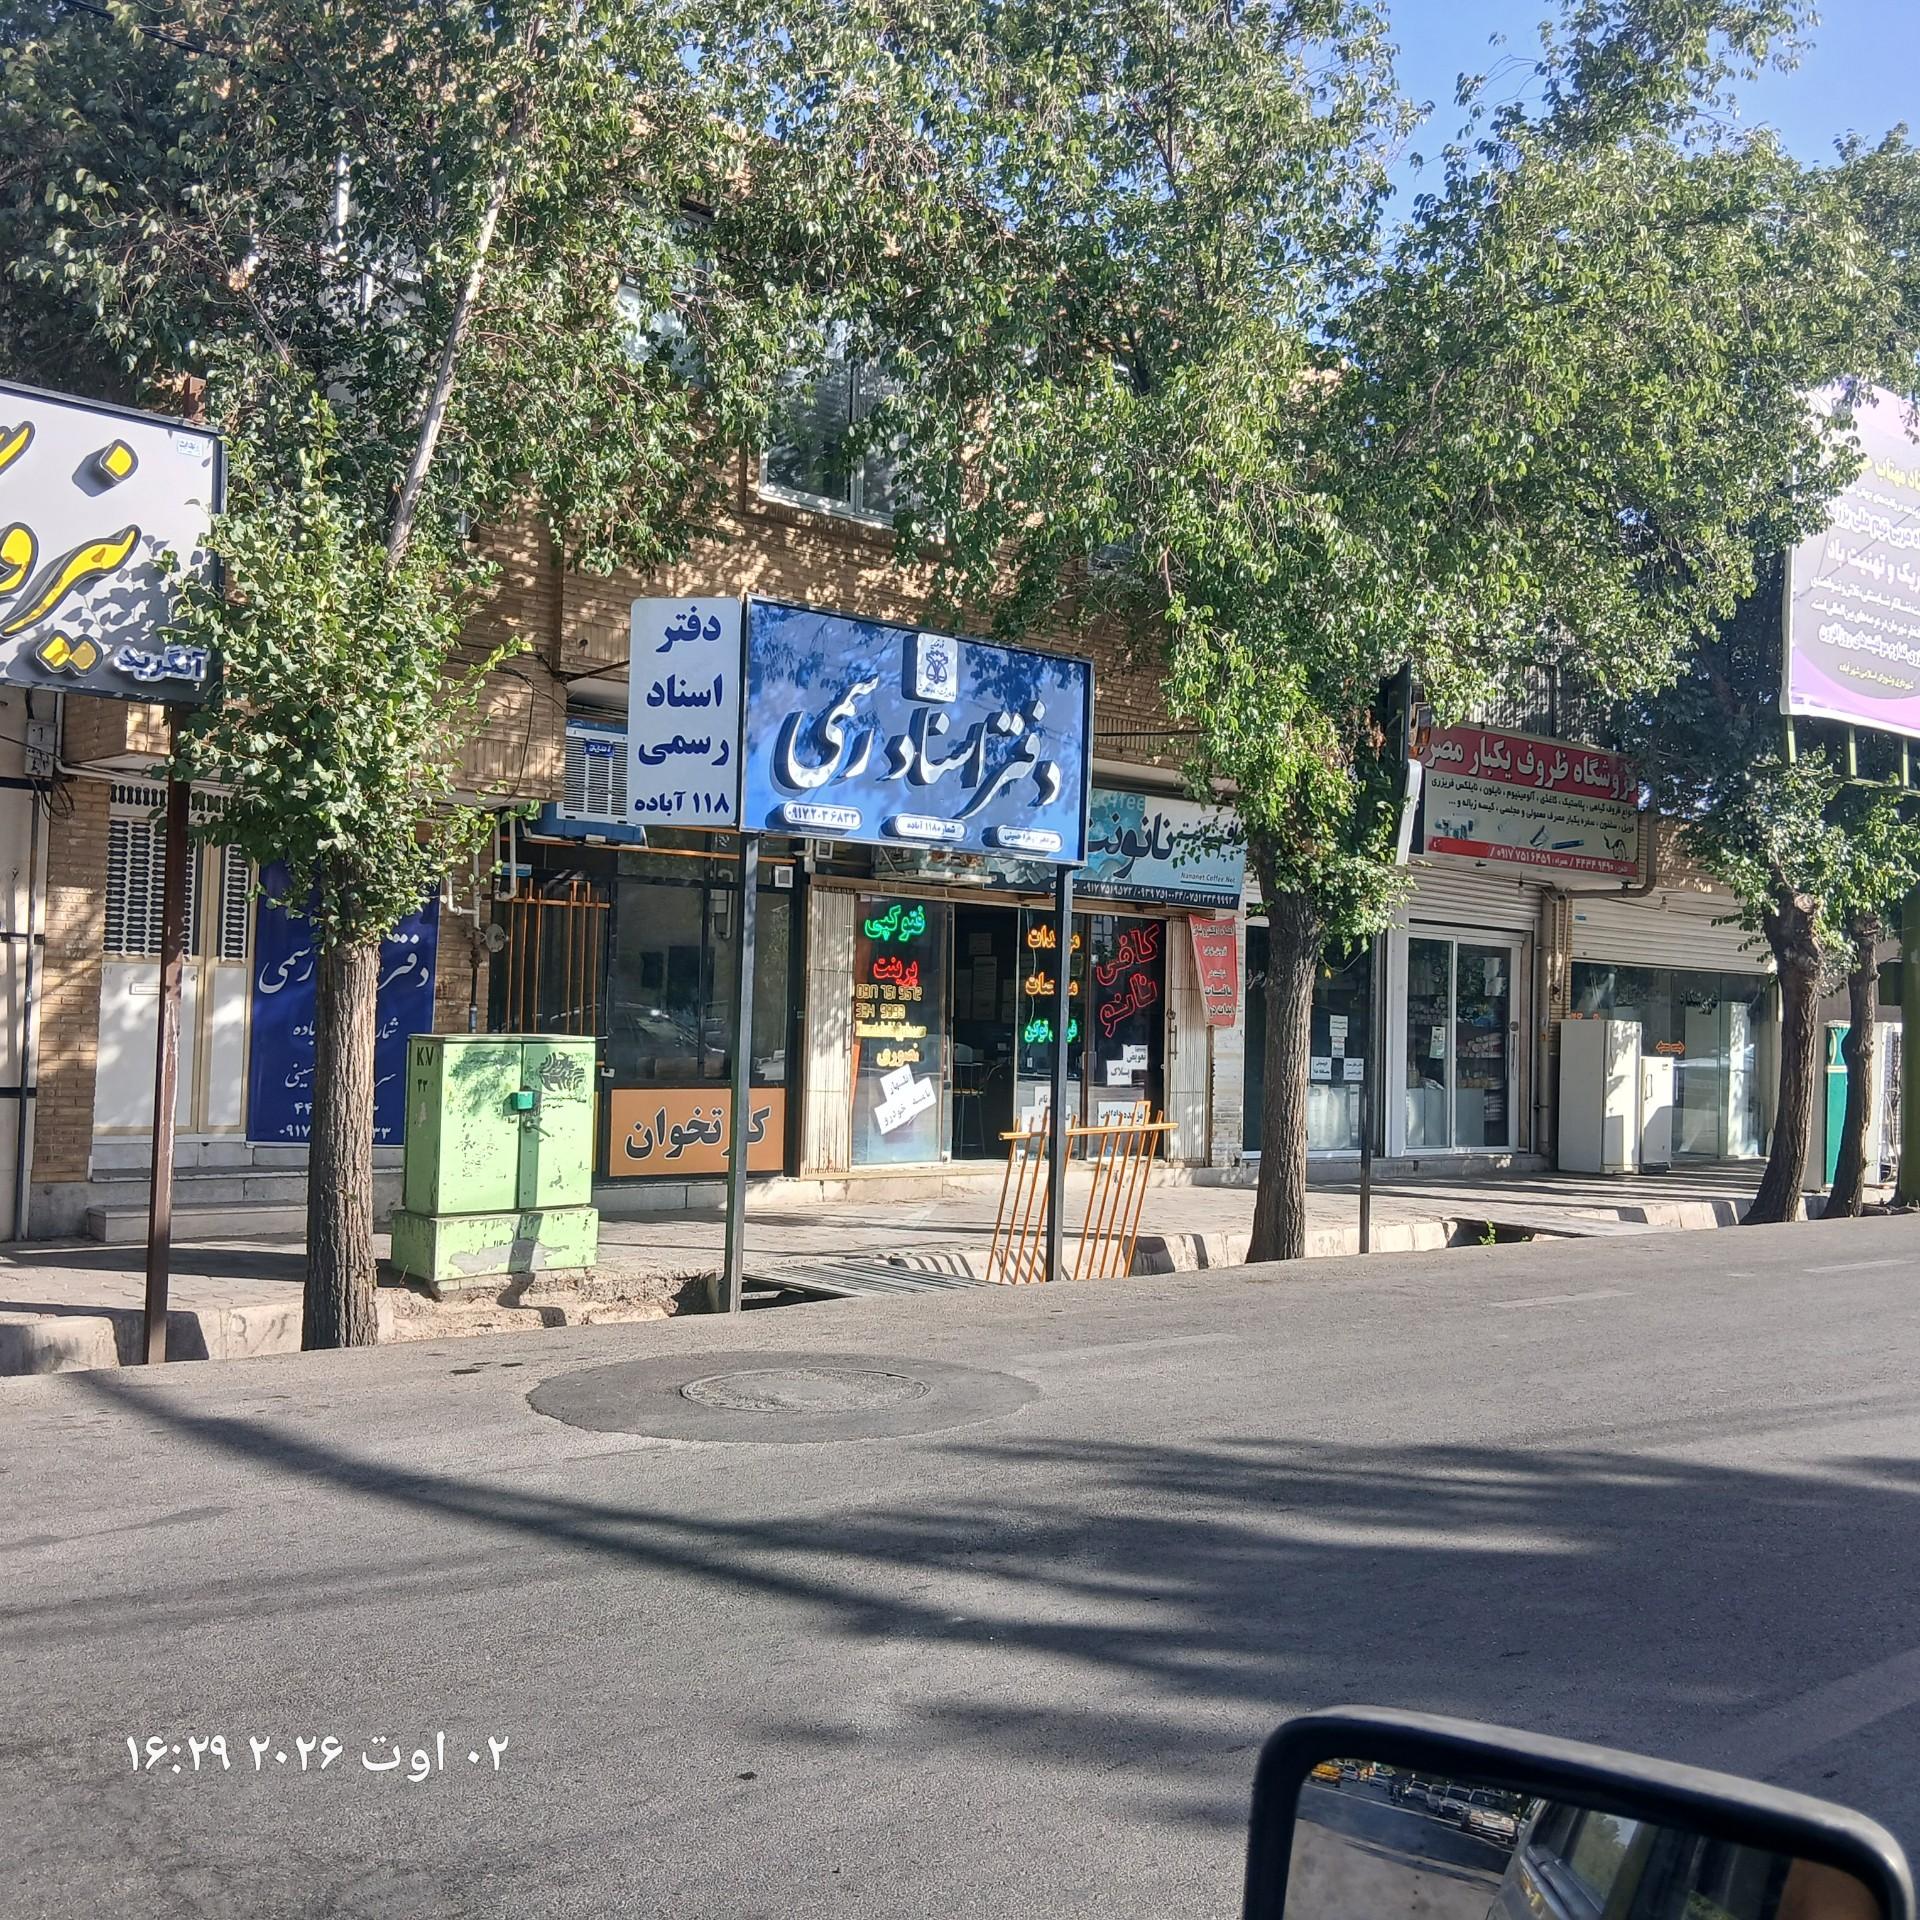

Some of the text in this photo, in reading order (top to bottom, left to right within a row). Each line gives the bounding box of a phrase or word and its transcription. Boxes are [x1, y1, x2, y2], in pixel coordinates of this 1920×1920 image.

[655, 605, 722, 653] دفتر
[646, 673, 723, 707] اسناد
[638, 734, 730, 766] رسمی
[785, 673, 1062, 820] دفتر اسناد رسمی
[1424, 738, 1464, 768] مصر
[1468, 736, 1512, 779] یکبار
[1517, 743, 1569, 788] ظروف
[634, 790, 730, 817] ۱۱۸ آباده
[1206, 873, 1224, 882] Coffee
[864, 904, 926, 942] فتوکپی
[258, 932, 430, 994] دفتر رسمی
[873, 955, 919, 987] پرینت
[1096, 923, 1160, 986] کافی
[1100, 971, 1158, 1038] نانو
[292, 1016, 399, 1046] شمار باده
[284, 1060, 315, 1089] سینی
[1110, 1066, 1130, 1079] پلاک
[626, 1107, 771, 1159] کتخوان
